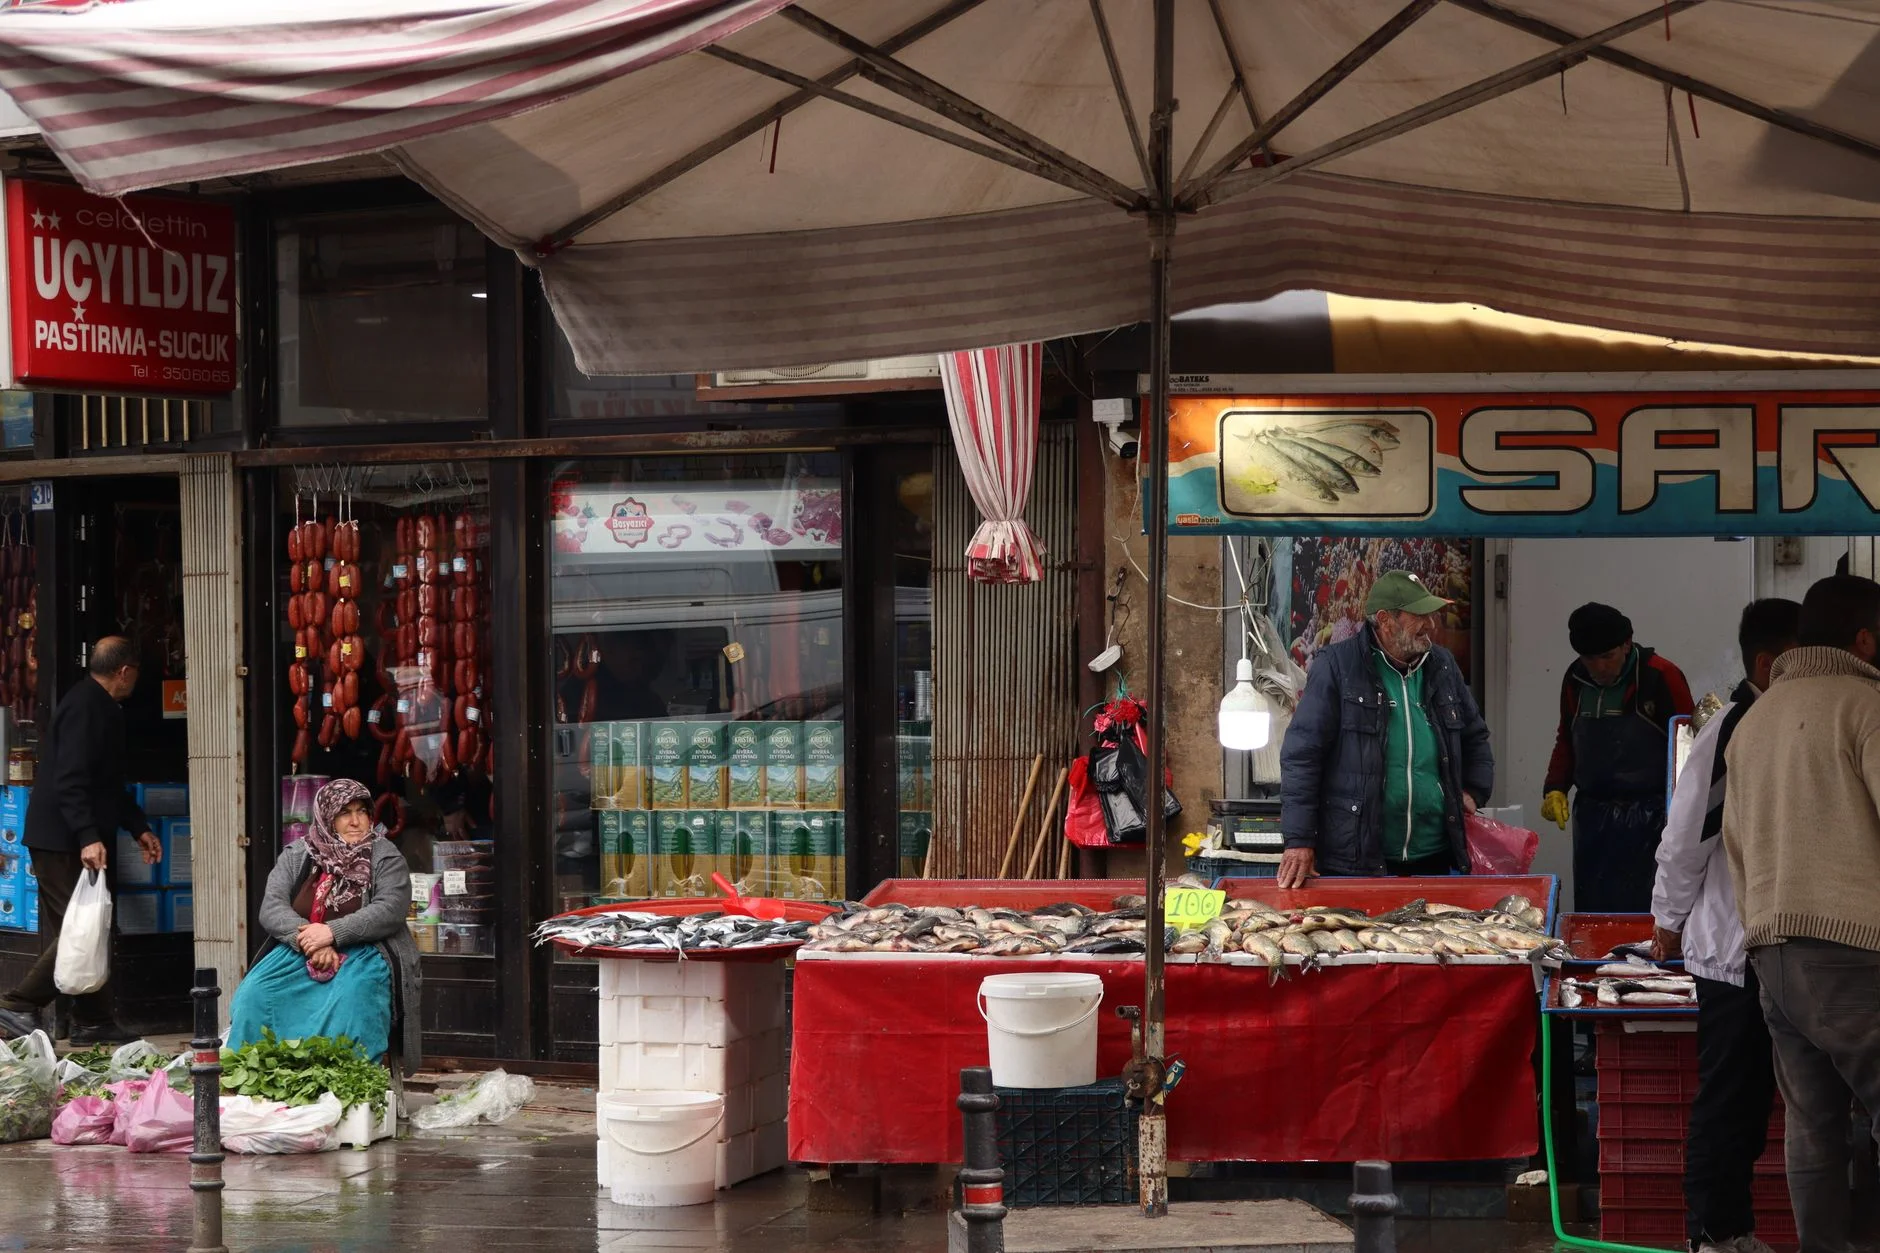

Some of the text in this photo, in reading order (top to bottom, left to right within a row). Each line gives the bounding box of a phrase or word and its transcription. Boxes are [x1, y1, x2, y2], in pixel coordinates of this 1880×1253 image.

[76, 208, 207, 239] celalettin
[35, 319, 229, 363] PASTIRMA-SUCUK
[131, 364, 149, 378] Tel
[162, 366, 231, 383] 3506065
